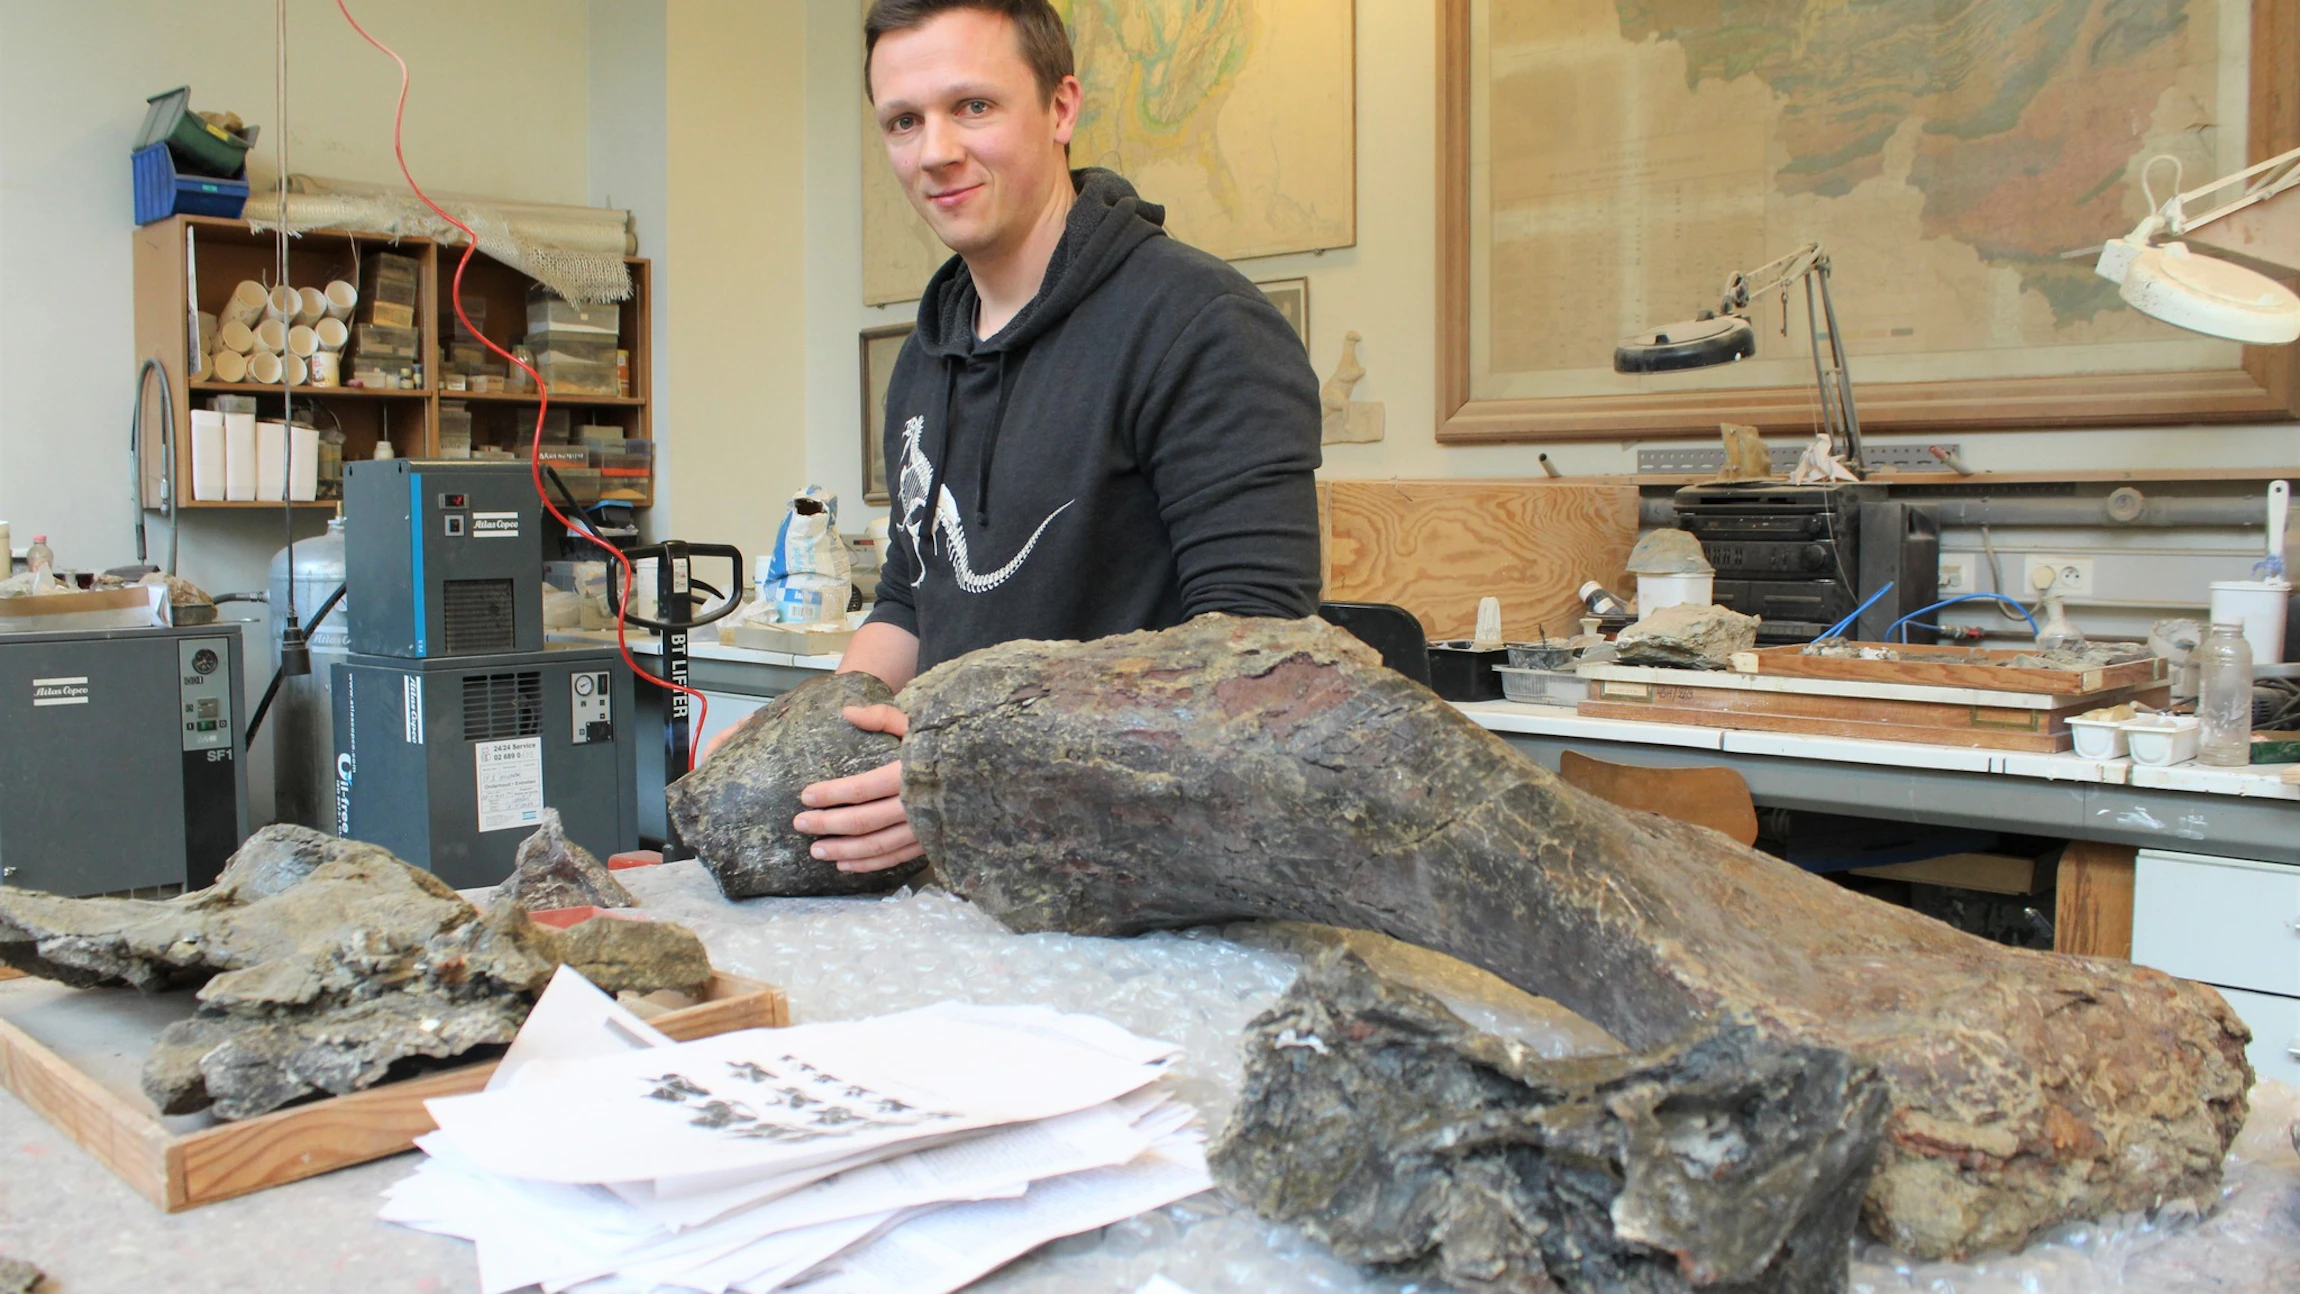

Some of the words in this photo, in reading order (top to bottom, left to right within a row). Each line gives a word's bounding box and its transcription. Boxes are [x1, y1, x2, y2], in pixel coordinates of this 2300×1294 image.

[473, 520, 495, 529] Atlas
[496, 519, 519, 530] Copco
[313, 633, 341, 645] Atlas
[671, 634, 686, 655] BT
[33, 687, 62, 697] Atlas
[62, 685, 89, 696] Copco
[410, 710, 418, 744] Copco
[207, 749, 233, 762] SF1
